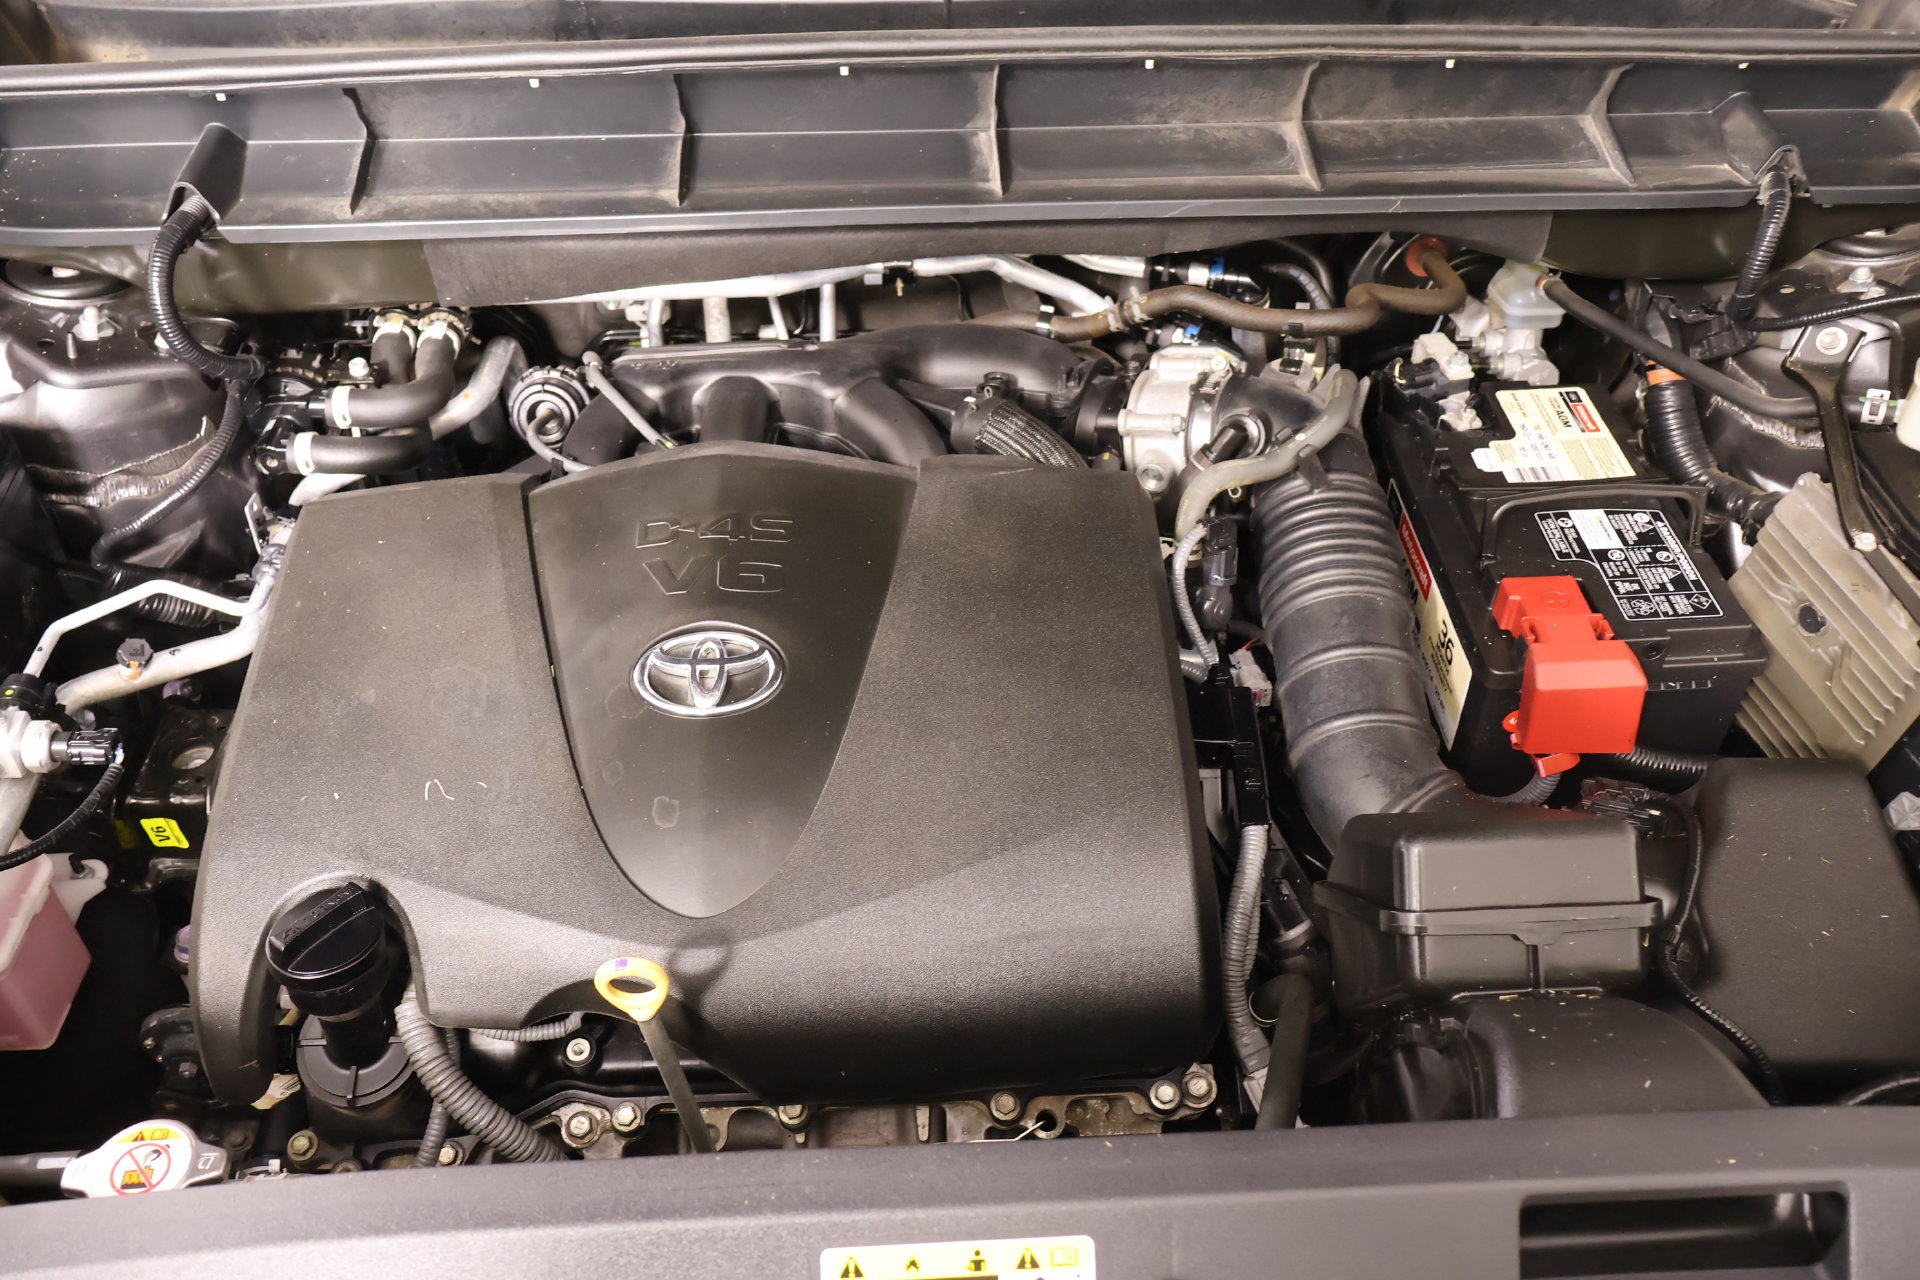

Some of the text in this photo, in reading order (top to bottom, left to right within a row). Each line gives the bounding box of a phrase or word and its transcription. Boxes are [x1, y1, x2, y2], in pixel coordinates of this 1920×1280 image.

[1555, 410, 1572, 428] AGM
[642, 554, 785, 596] V6
[1438, 619, 1456, 665] 36
[151, 826, 171, 843] V6
